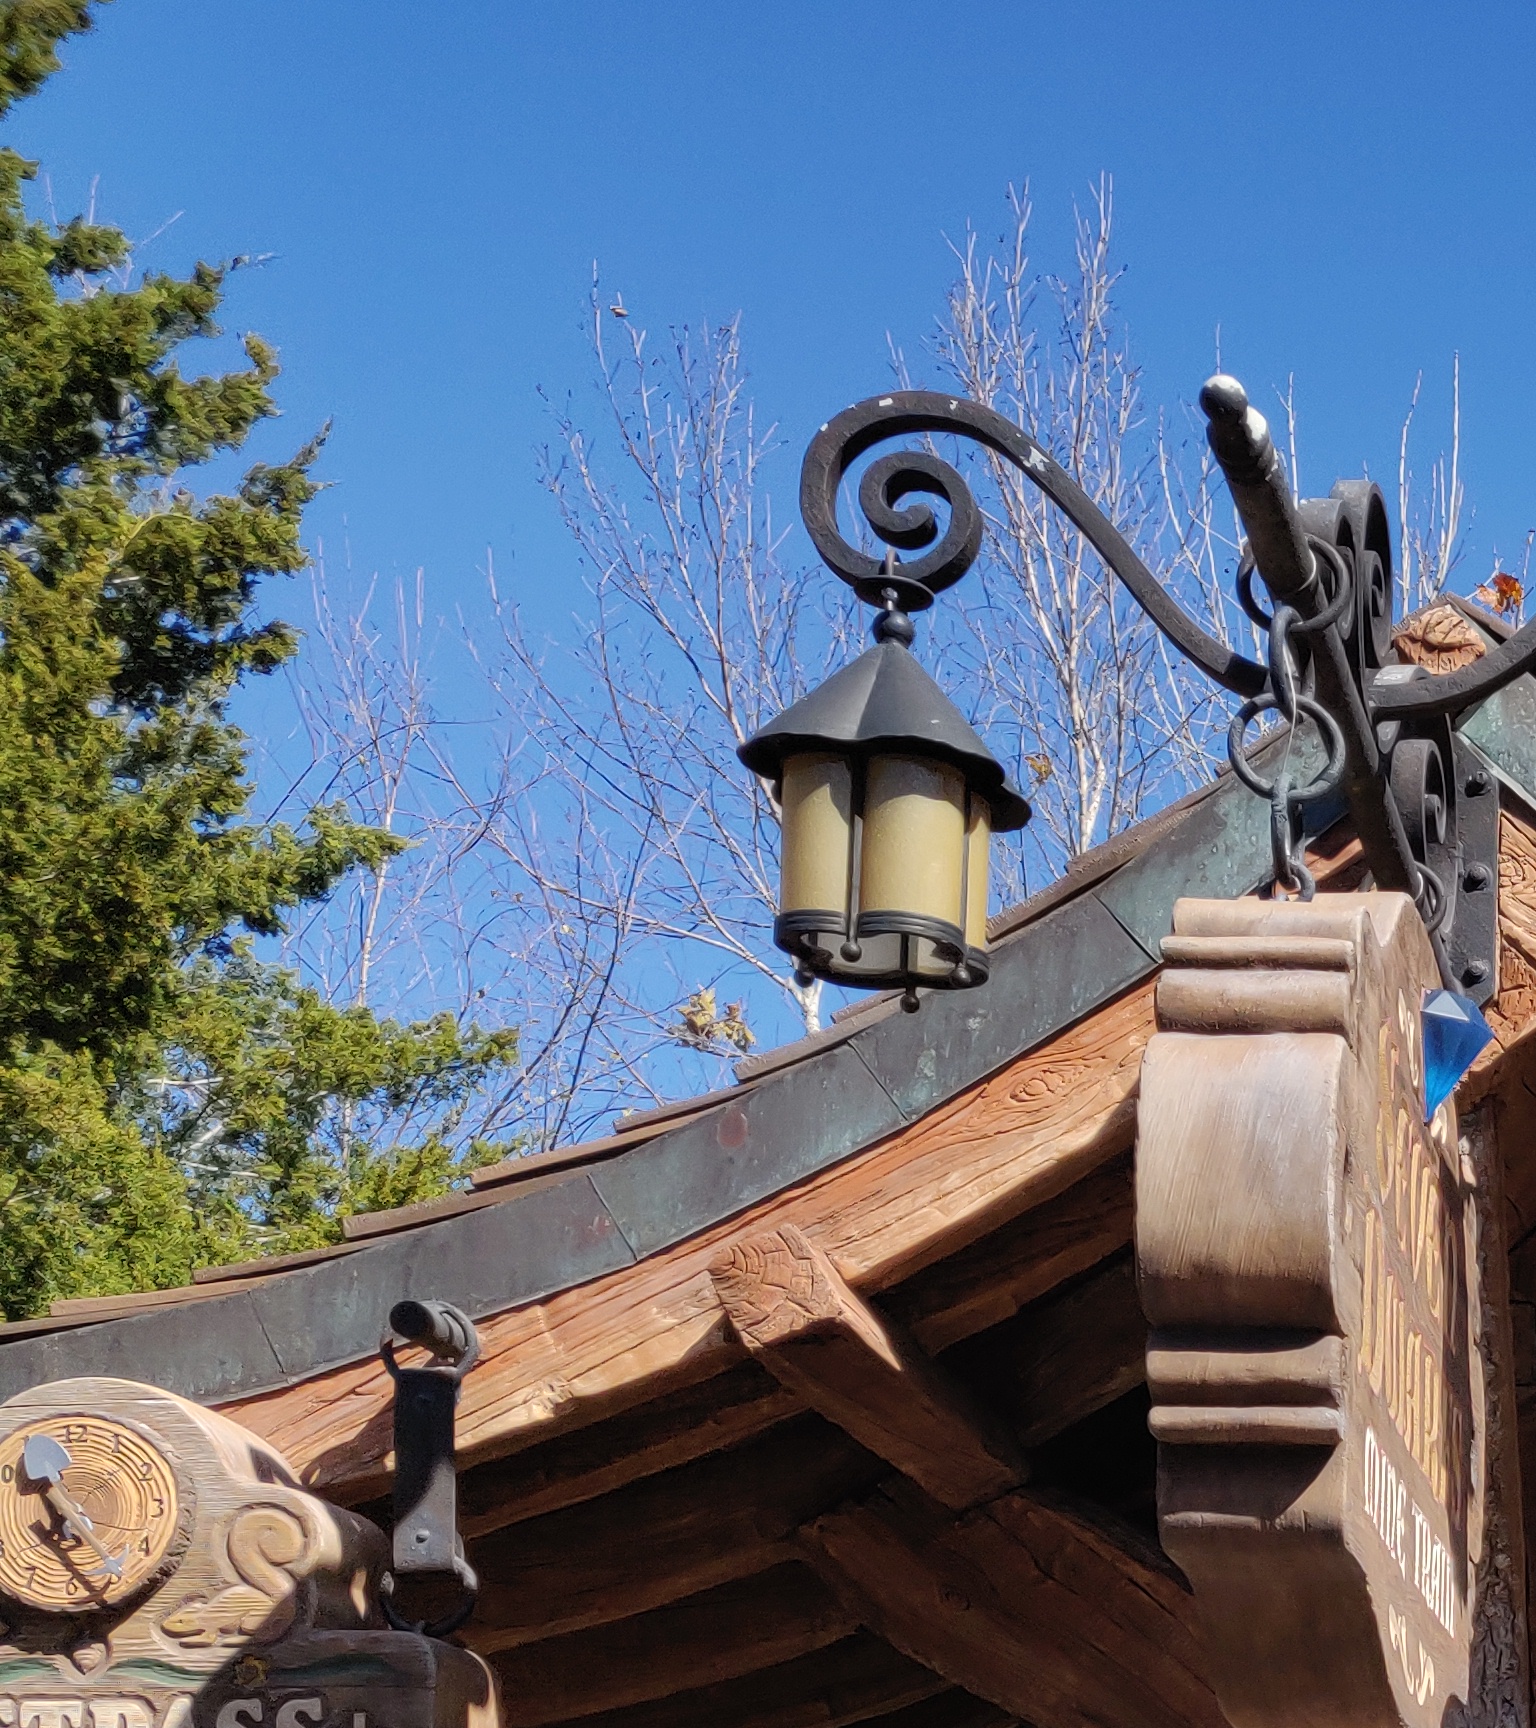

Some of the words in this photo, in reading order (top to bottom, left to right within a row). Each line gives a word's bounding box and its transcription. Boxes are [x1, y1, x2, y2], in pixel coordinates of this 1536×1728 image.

[65, 1425, 87, 1443] 12
[150, 1498, 164, 1518] 3
[1364, 1424, 1407, 1583] MINE
[1411, 1498, 1454, 1639] TRAIN
